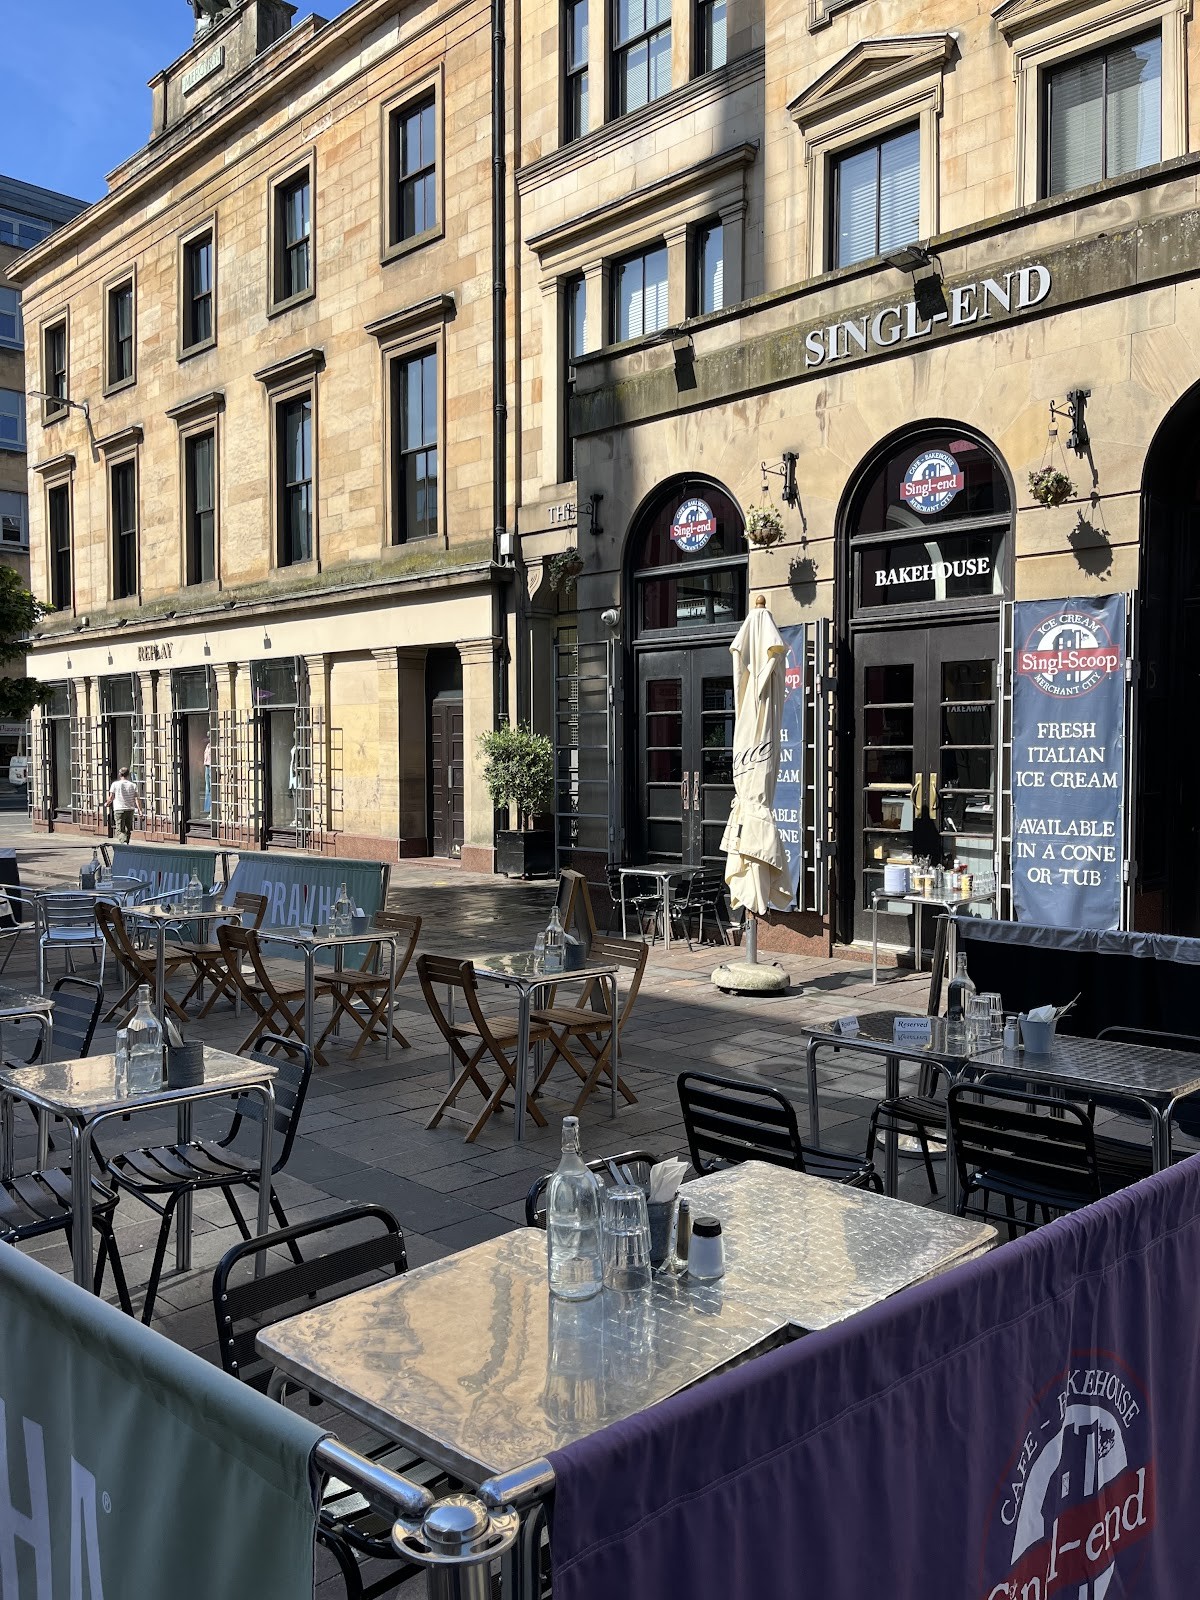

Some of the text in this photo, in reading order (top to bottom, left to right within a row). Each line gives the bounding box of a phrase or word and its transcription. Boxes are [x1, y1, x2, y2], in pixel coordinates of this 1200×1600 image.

[805, 265, 1052, 367] SINGL-END
[905, 475, 957, 497] Singl-end
[909, 492, 953, 512] MERCHANT CITY
[548, 502, 576, 524] THE
[674, 520, 711, 538] Singl-end
[875, 557, 990, 587] BAKEHOUSE
[1037, 614, 1101, 635] ICE CREAM
[1022, 651, 1117, 675] Singl-Scoop
[1034, 672, 1101, 696] MERCHANT CITY
[1037, 722, 1096, 740] FRESH
[1028, 747, 1105, 763] ITALIAN
[1016, 771, 1118, 789] ICE CREAM
[1018, 818, 1115, 837] AVAILABLE
[1017, 842, 1116, 862] IN A CONE
[1027, 867, 1101, 886] OR TUB
[897, 1020, 929, 1029] Reserved
[1000, 1431, 1038, 1525] CAFE
